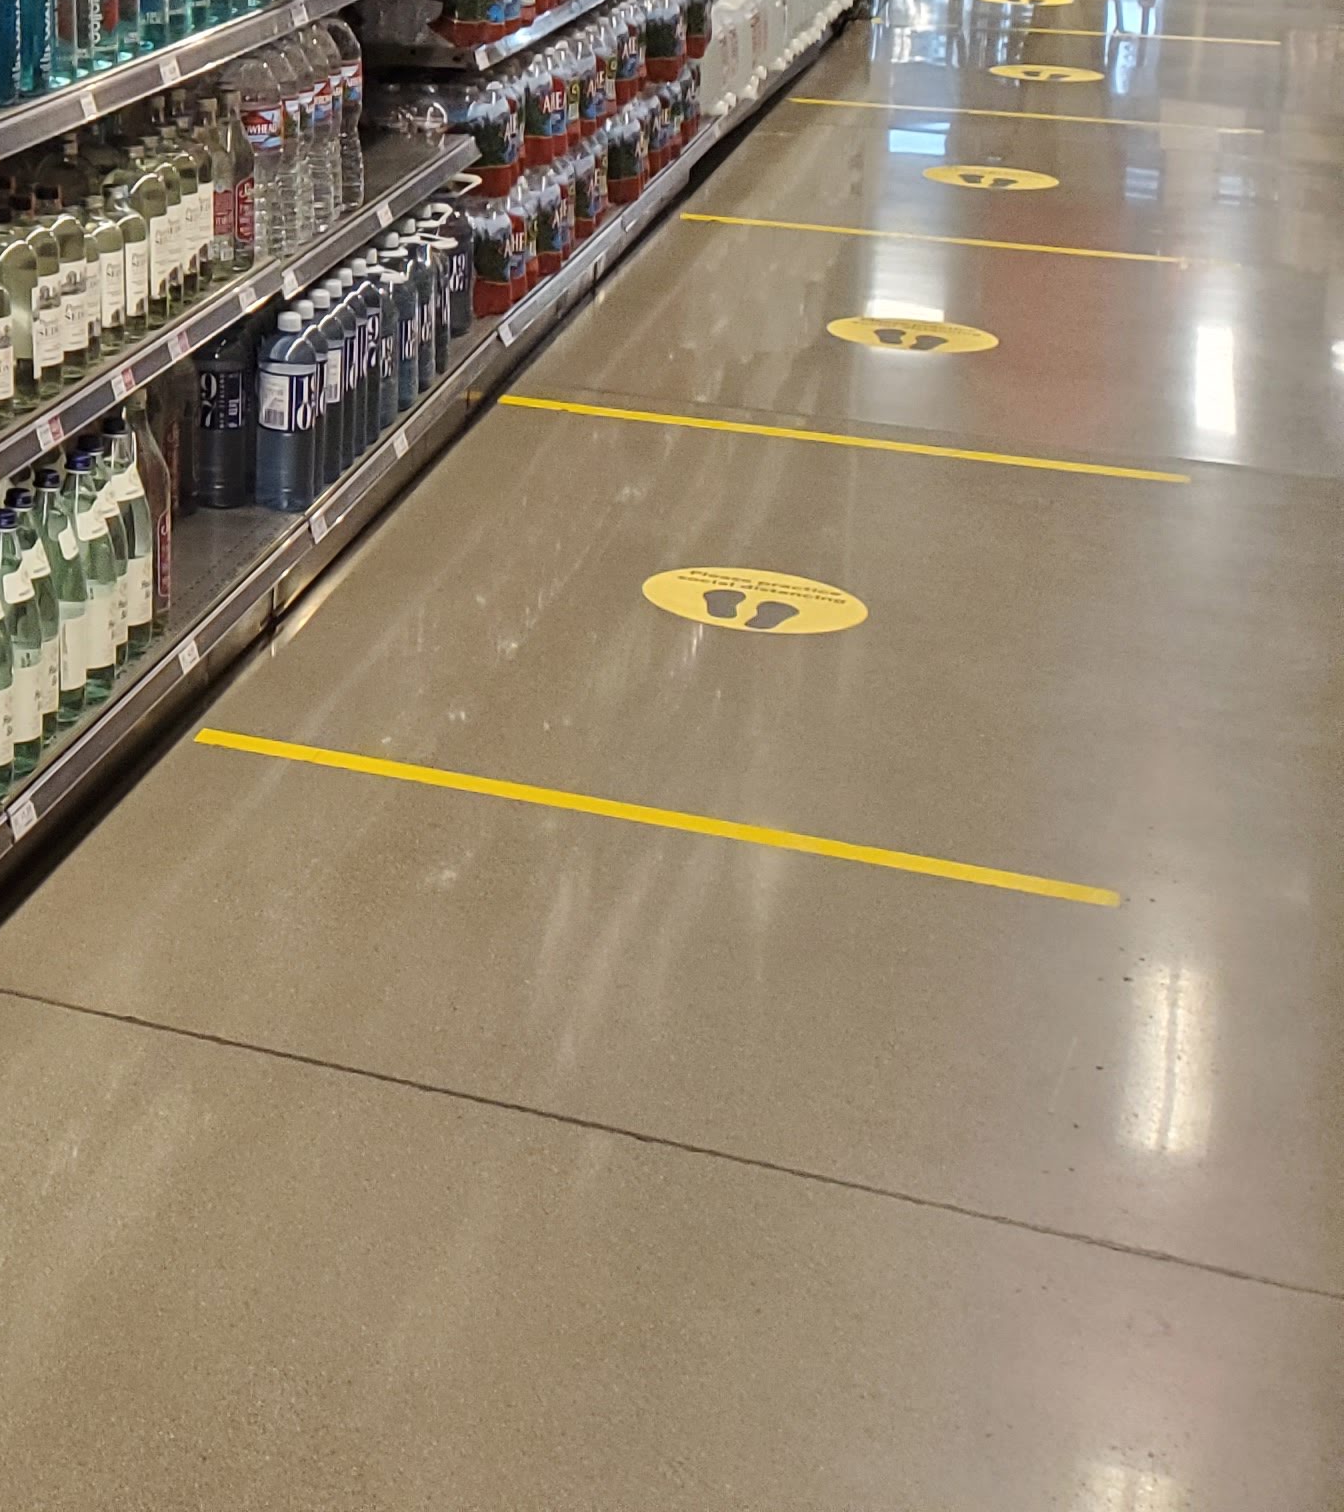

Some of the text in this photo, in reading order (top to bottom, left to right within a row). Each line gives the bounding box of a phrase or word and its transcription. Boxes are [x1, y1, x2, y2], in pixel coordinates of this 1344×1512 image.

[677, 575, 847, 605] social distancing
[690, 570, 842, 597] Please practice
